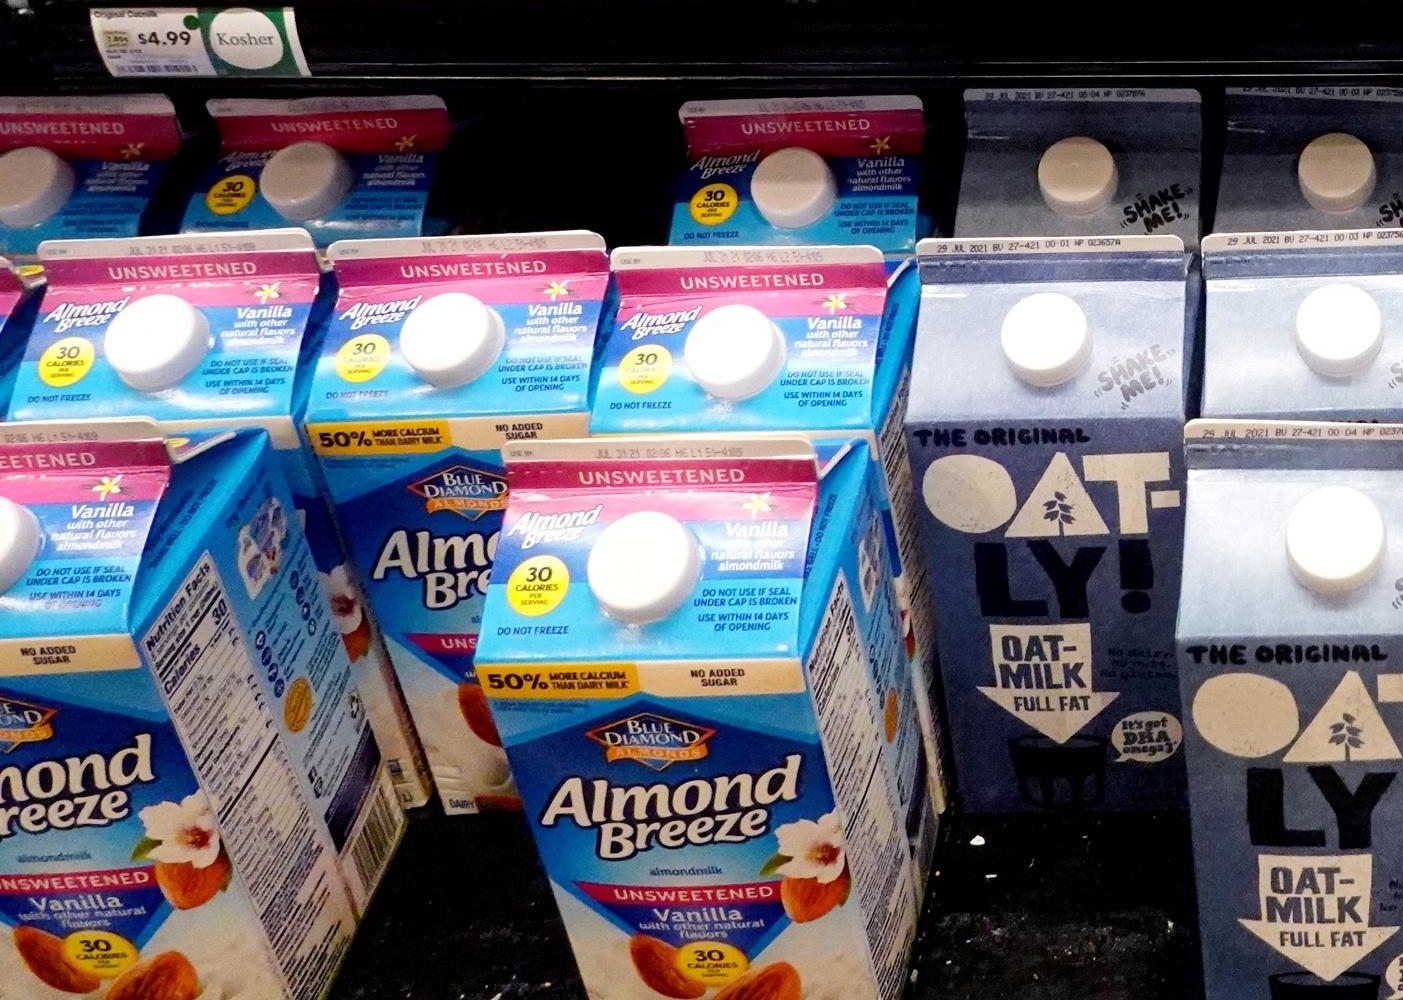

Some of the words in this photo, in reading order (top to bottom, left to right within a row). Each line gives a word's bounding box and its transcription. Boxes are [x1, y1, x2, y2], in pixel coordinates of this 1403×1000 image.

[138, 31, 191, 46] $4.99
[216, 33, 274, 46] Kosher
[741, 119, 870, 135] UNSWEETENED
[108, 262, 256, 280] UNSWEETENED
[680, 273, 824, 290] UNSWEETENED
[807, 318, 862, 329] Vanilla
[319, 432, 373, 448] 50%
[914, 429, 967, 447] THE
[974, 428, 1091, 446] ORIGINAL
[579, 469, 745, 486] UNSWEETENED
[922, 452, 1180, 537] OAT-
[508, 505, 601, 536] Almond
[725, 522, 789, 537] Vanilla
[718, 561, 784, 571] almondmilk
[525, 567, 552, 582] 30
[974, 538, 1155, 618] LY!
[515, 583, 559, 592] CALORIES
[703, 588, 716, 597] DO
[718, 588, 736, 596] NOT
[739, 588, 757, 596] USE
[769, 587, 791, 596] SEAL
[146, 597, 187, 651] Nutrition
[185, 563, 210, 597] Facts
[694, 599, 726, 607] UNDER
[728, 598, 747, 606] CAP
[749, 598, 757, 606] IS
[759, 597, 797, 606] BROKEN
[497, 626, 511, 635] DO
[513, 626, 532, 635] NOT
[534, 626, 569, 635] FREEZE
[1185, 644, 1247, 665] THE
[1255, 644, 1388, 664] ORIGINAL
[164, 644, 201, 695] Calories
[549, 672, 578, 681] MORE
[580, 671, 626, 681] CALCIUM
[690, 669, 706, 678] NO
[708, 668, 745, 678] ADDED
[488, 673, 548, 690] 50%
[701, 677, 738, 687] SUGAR
[628, 720, 671, 735] BLUE
[605, 729, 700, 746] DIAMOND
[542, 755, 801, 827] Almond
[600, 808, 767, 859] Breeze
[649, 866, 722, 876] almondmilk
[1270, 867, 1355, 895] OAT-
[614, 884, 774, 902] UNSWEETENED
[652, 908, 743, 923] Vanilla
[1265, 897, 1363, 924] MILK
[1280, 931, 1322, 947] FULL
[1330, 931, 1367, 947] FAT
[693, 948, 724, 962] 30
